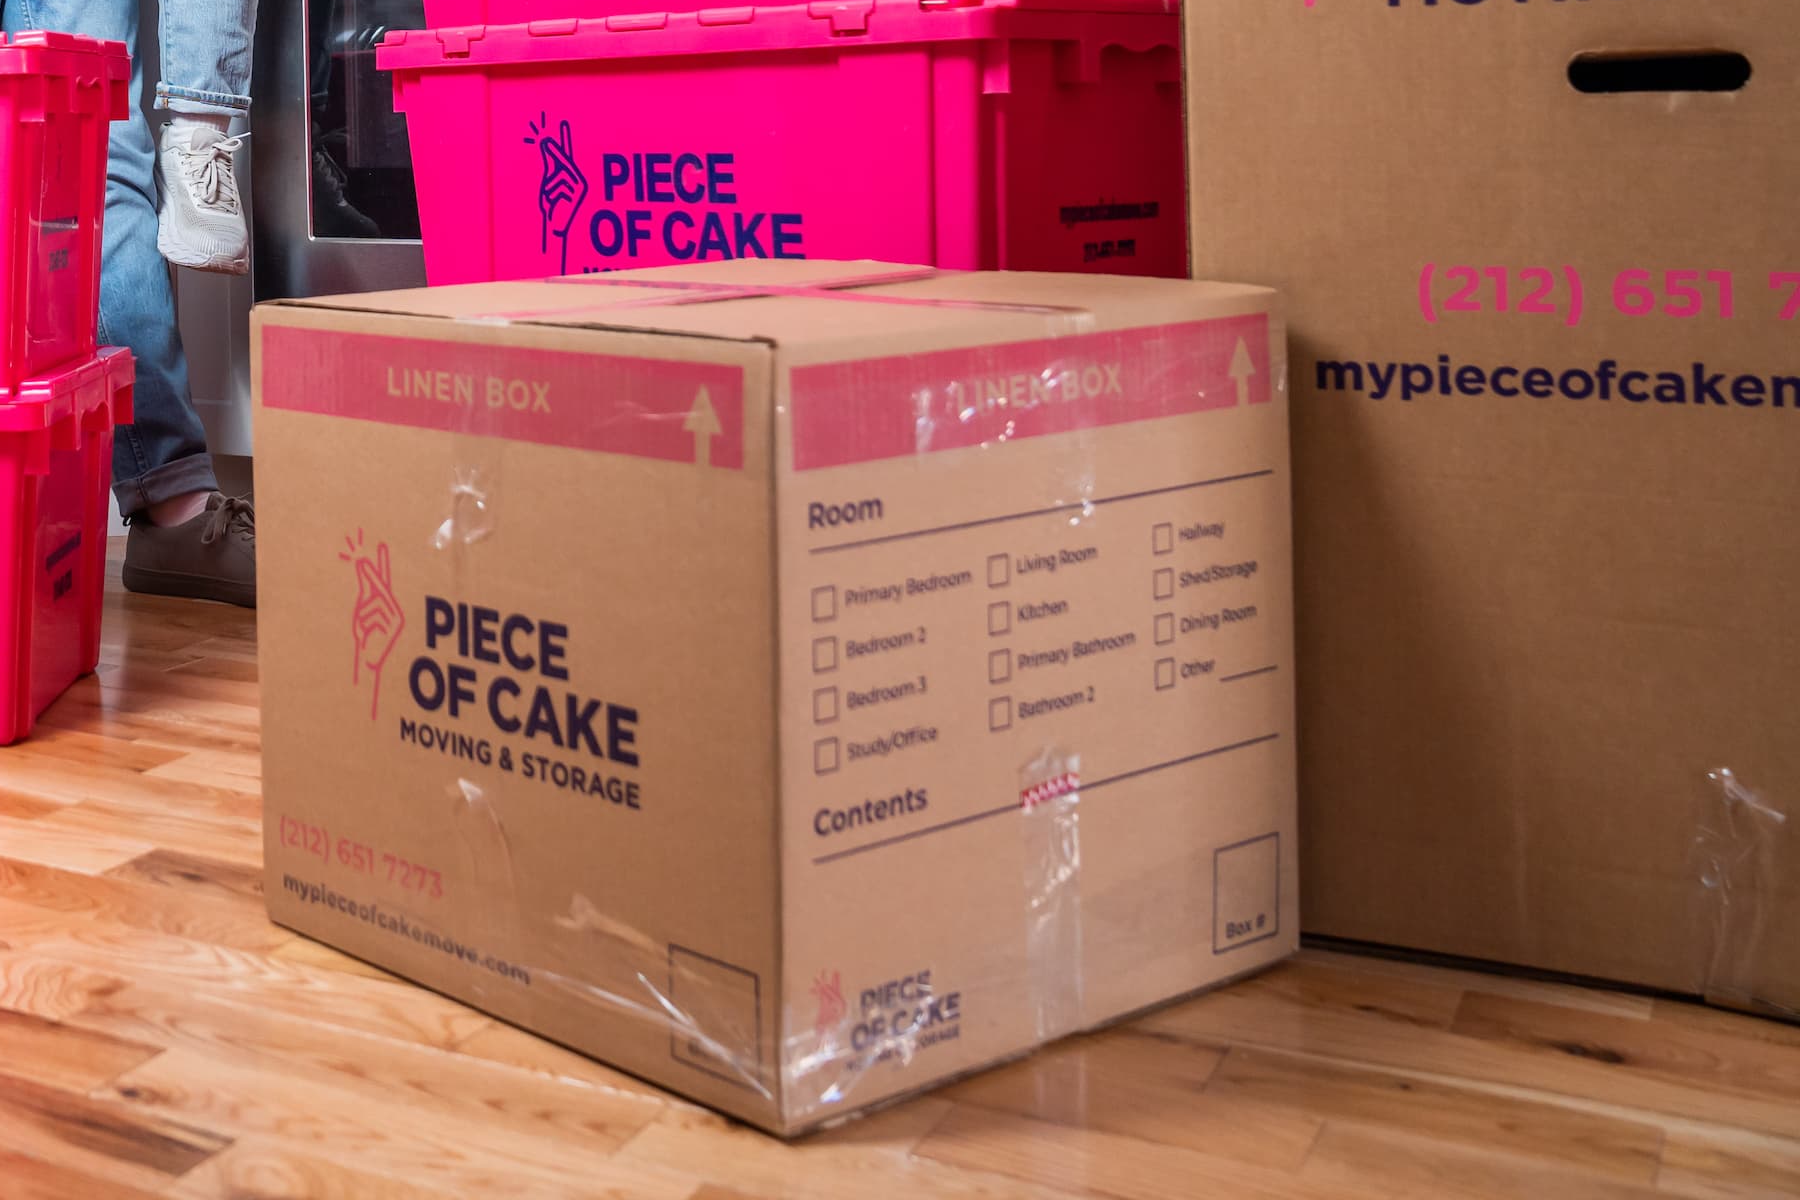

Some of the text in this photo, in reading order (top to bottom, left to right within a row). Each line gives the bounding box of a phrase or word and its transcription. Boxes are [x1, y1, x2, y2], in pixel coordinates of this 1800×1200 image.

[603, 153, 737, 204] PIECE
[590, 209, 806, 260] OF CAKE
[1418, 263, 1584, 326] (212)
[1612, 269, 1734, 319] 651
[387, 366, 551, 413] LINEN BOX
[1061, 362, 1123, 403] BOX
[808, 498, 884, 529] Room
[1017, 547, 1097, 575] Living Room
[845, 569, 972, 607] Primary Bedroom
[1017, 599, 1068, 623] Kitchen
[1180, 605, 1257, 635] Dining Room
[425, 595, 569, 681] PIECE
[846, 627, 927, 659] Bedroom 2
[1017, 632, 1136, 670] Primary Bathroom
[1180, 658, 1215, 679] Other
[846, 675, 927, 709] Bedroom 3
[1018, 685, 1095, 720] Bathroom 2
[409, 656, 639, 768] OF CAKE
[847, 725, 938, 761] Study/Office
[401, 717, 641, 810] MOVING & STORAGE
[813, 788, 928, 837] Contents
[279, 815, 444, 899] (212) 651 7273
[283, 871, 531, 987] mypieceofcakemove.com
